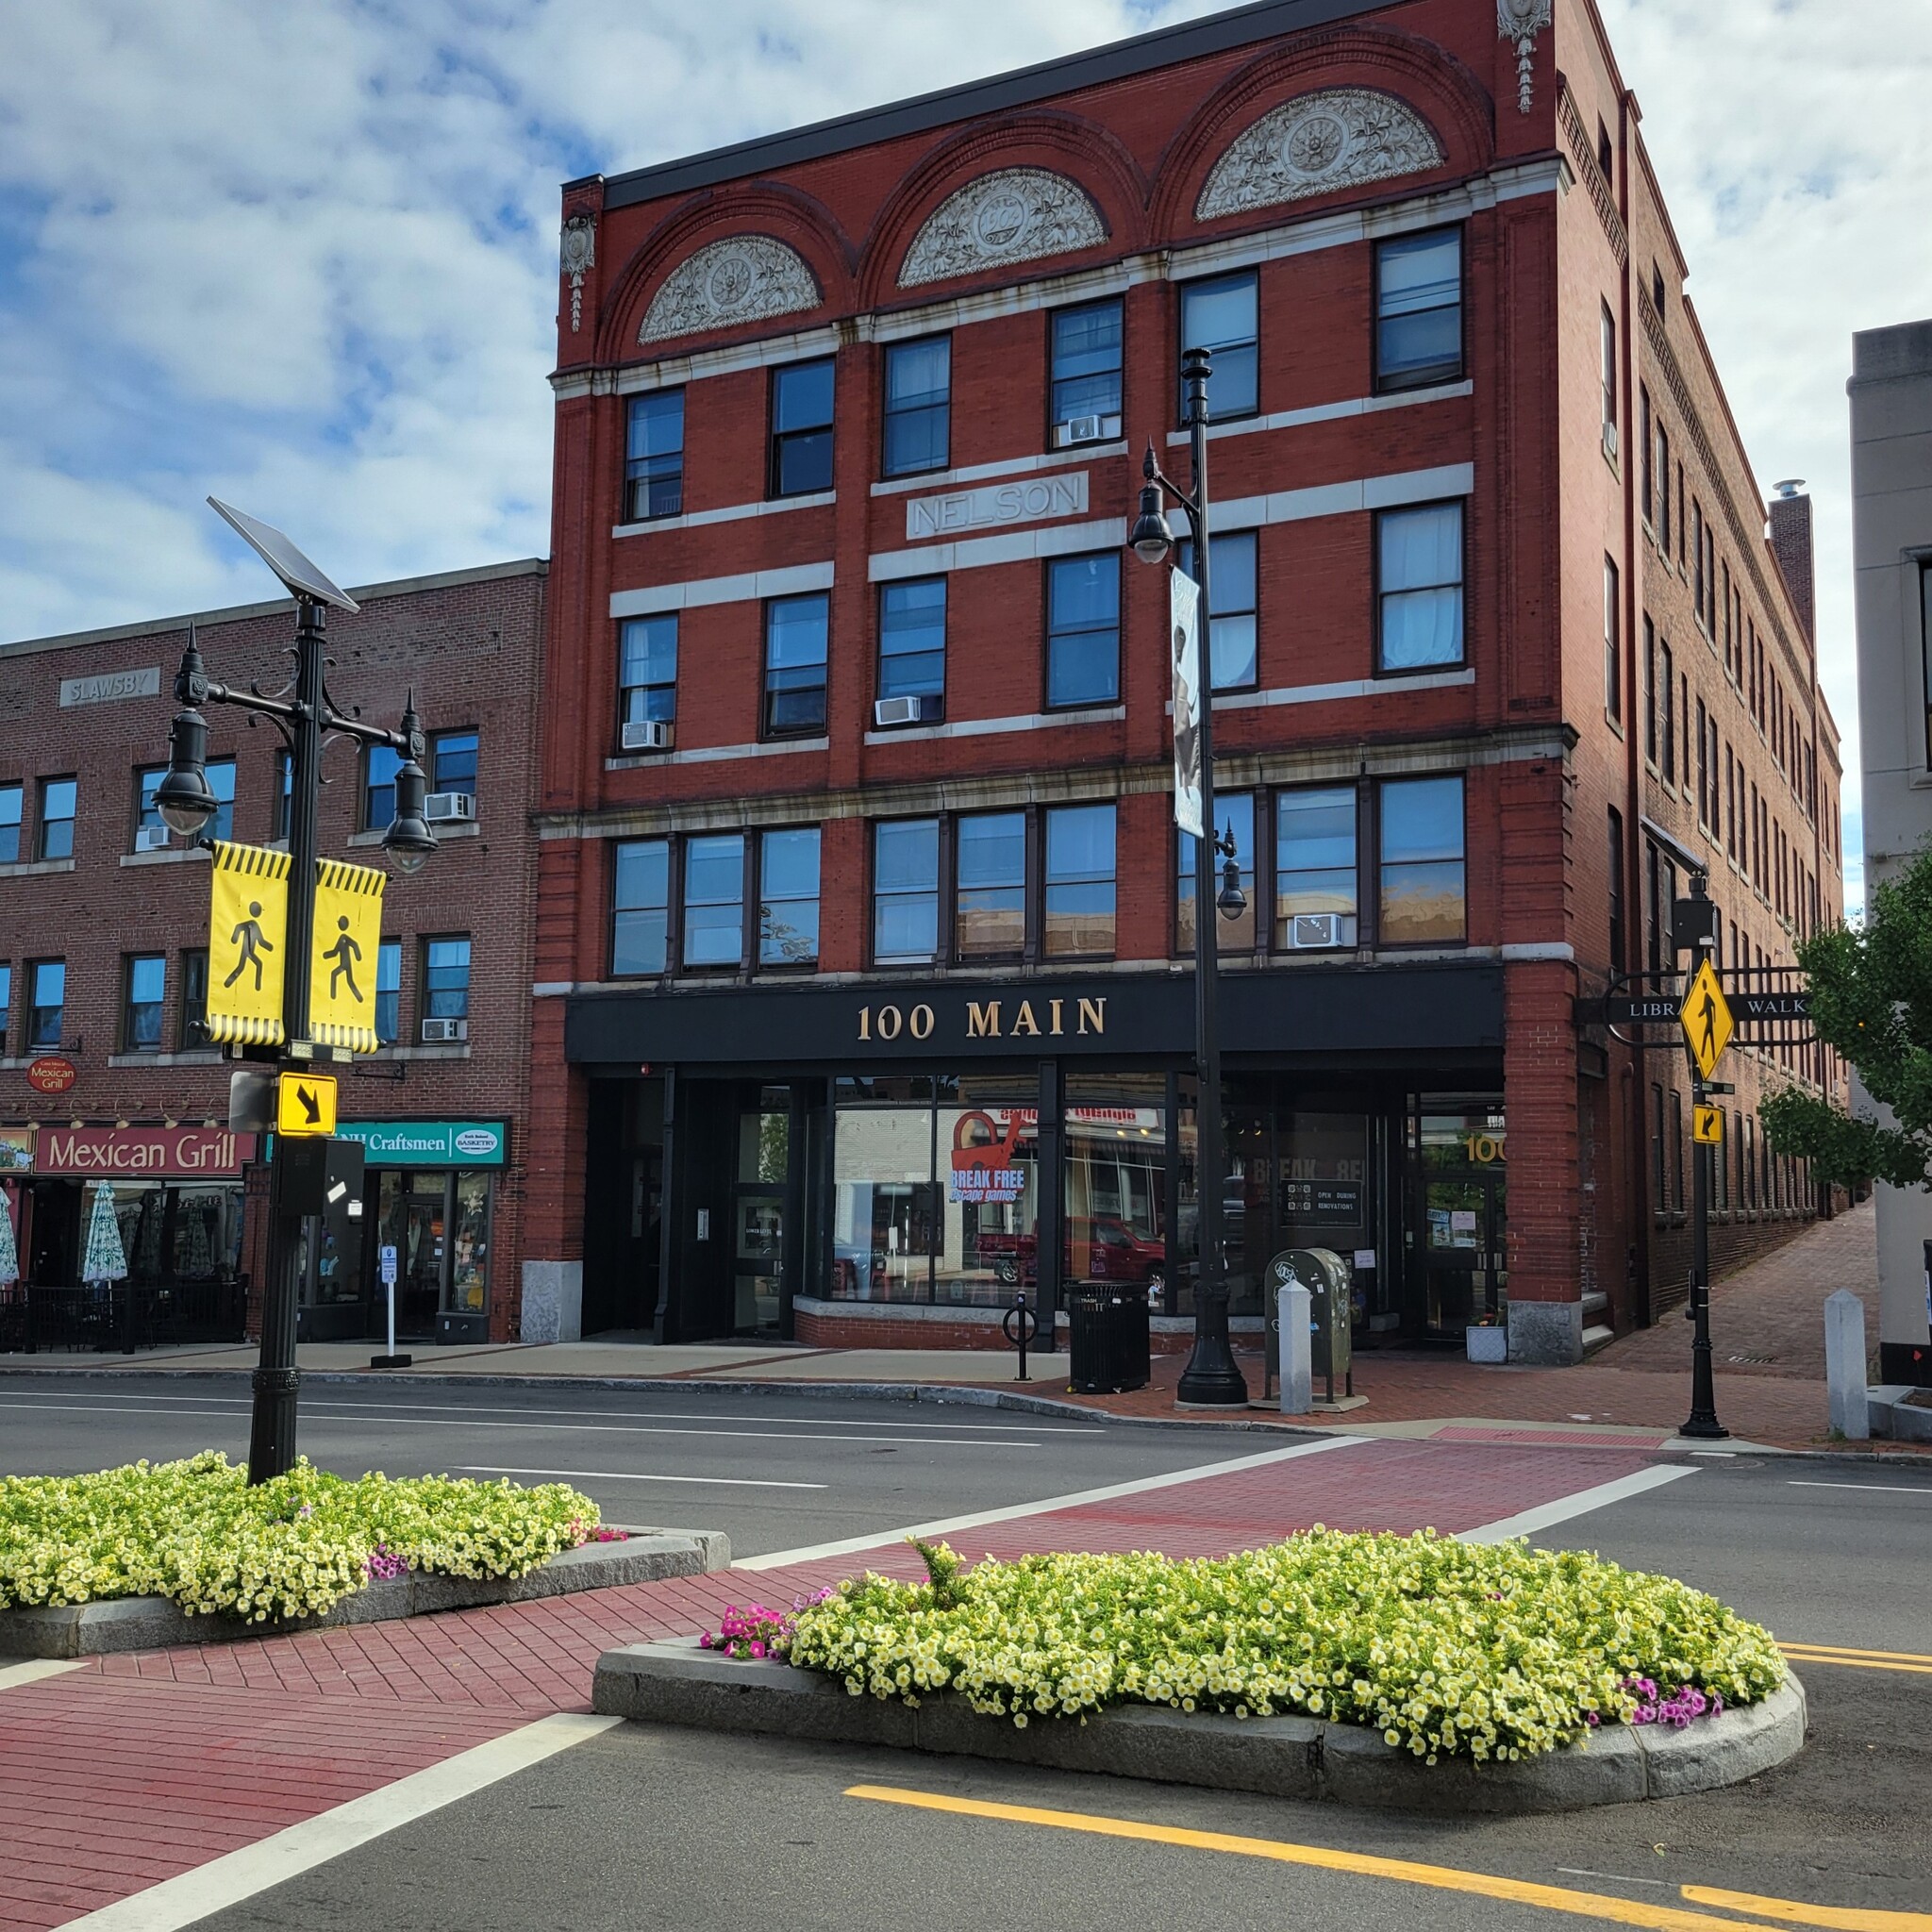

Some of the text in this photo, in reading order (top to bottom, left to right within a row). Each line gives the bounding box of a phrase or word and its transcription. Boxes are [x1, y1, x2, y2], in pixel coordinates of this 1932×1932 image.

[913, 475, 1080, 535] NELSON
[72, 674, 148, 701] SLAWSBY
[1747, 999, 1807, 1013] WALK
[857, 997, 1108, 1041] 100 MAIN
[32, 1067, 75, 1078] Mexican
[42, 1077, 63, 1089] Grill
[49, 1132, 236, 1168] Mexican Grill
[370, 1132, 446, 1151] Craftsmen
[951, 1170, 1024, 1189] BREAK FREE
[950, 1190, 1018, 1203] escape games
